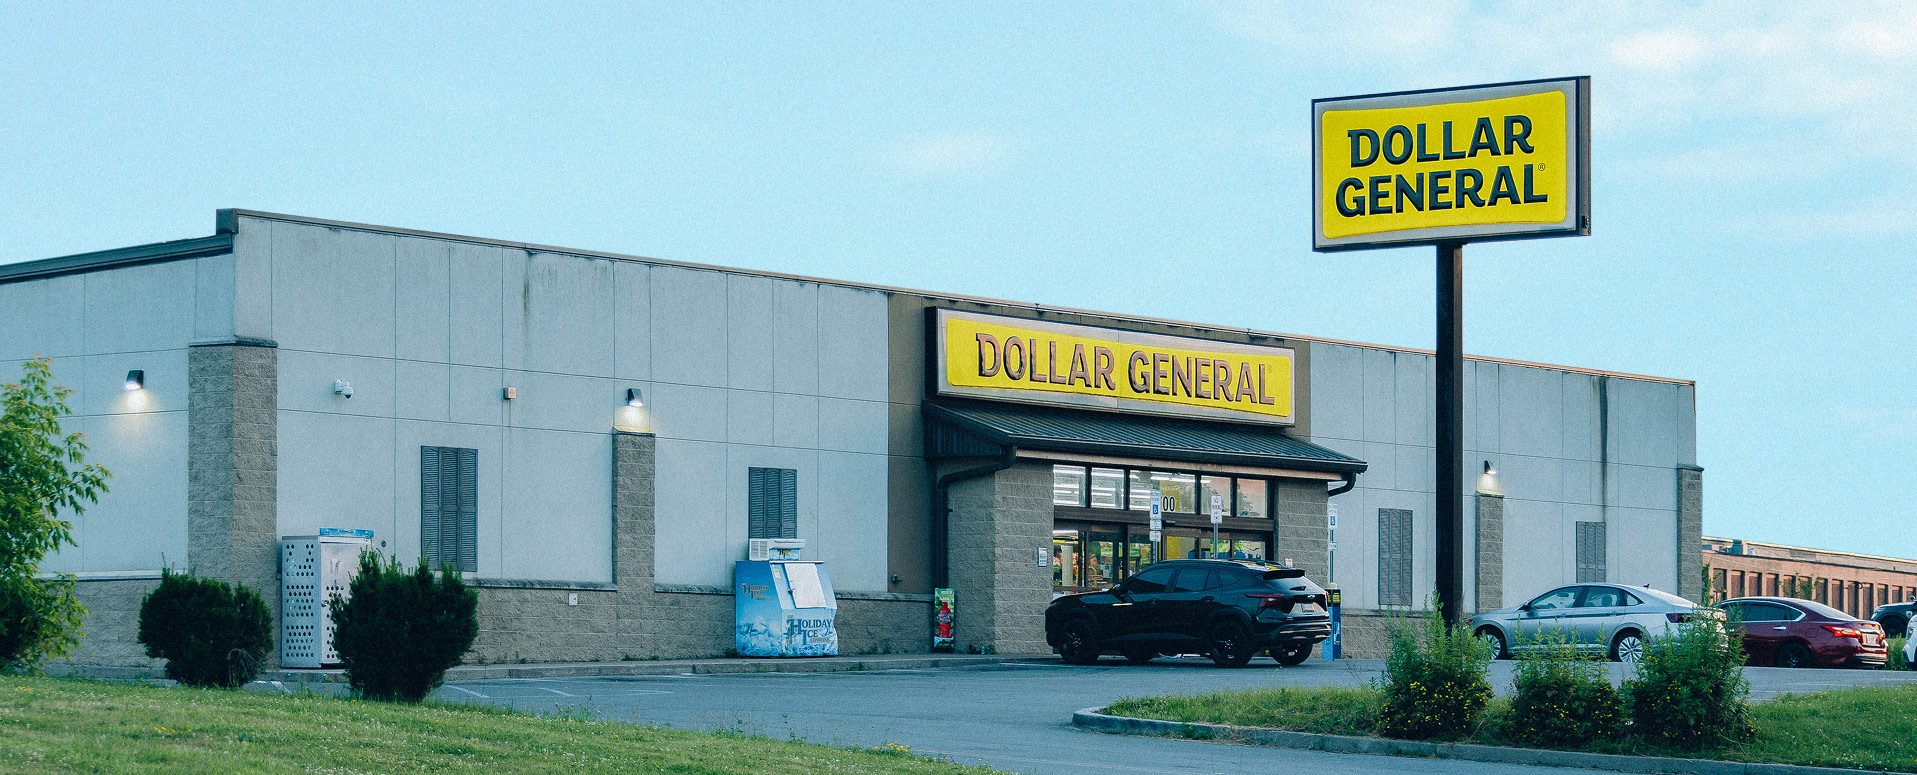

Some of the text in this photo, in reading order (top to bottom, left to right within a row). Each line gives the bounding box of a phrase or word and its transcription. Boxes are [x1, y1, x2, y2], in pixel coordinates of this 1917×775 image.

[1347, 114, 1535, 168] DOLLAR
[975, 332, 1116, 390] DOLLAR
[1161, 495, 1176, 512] 00
[786, 618, 833, 635] HOLIDAY
[801, 629, 819, 645] ICE
